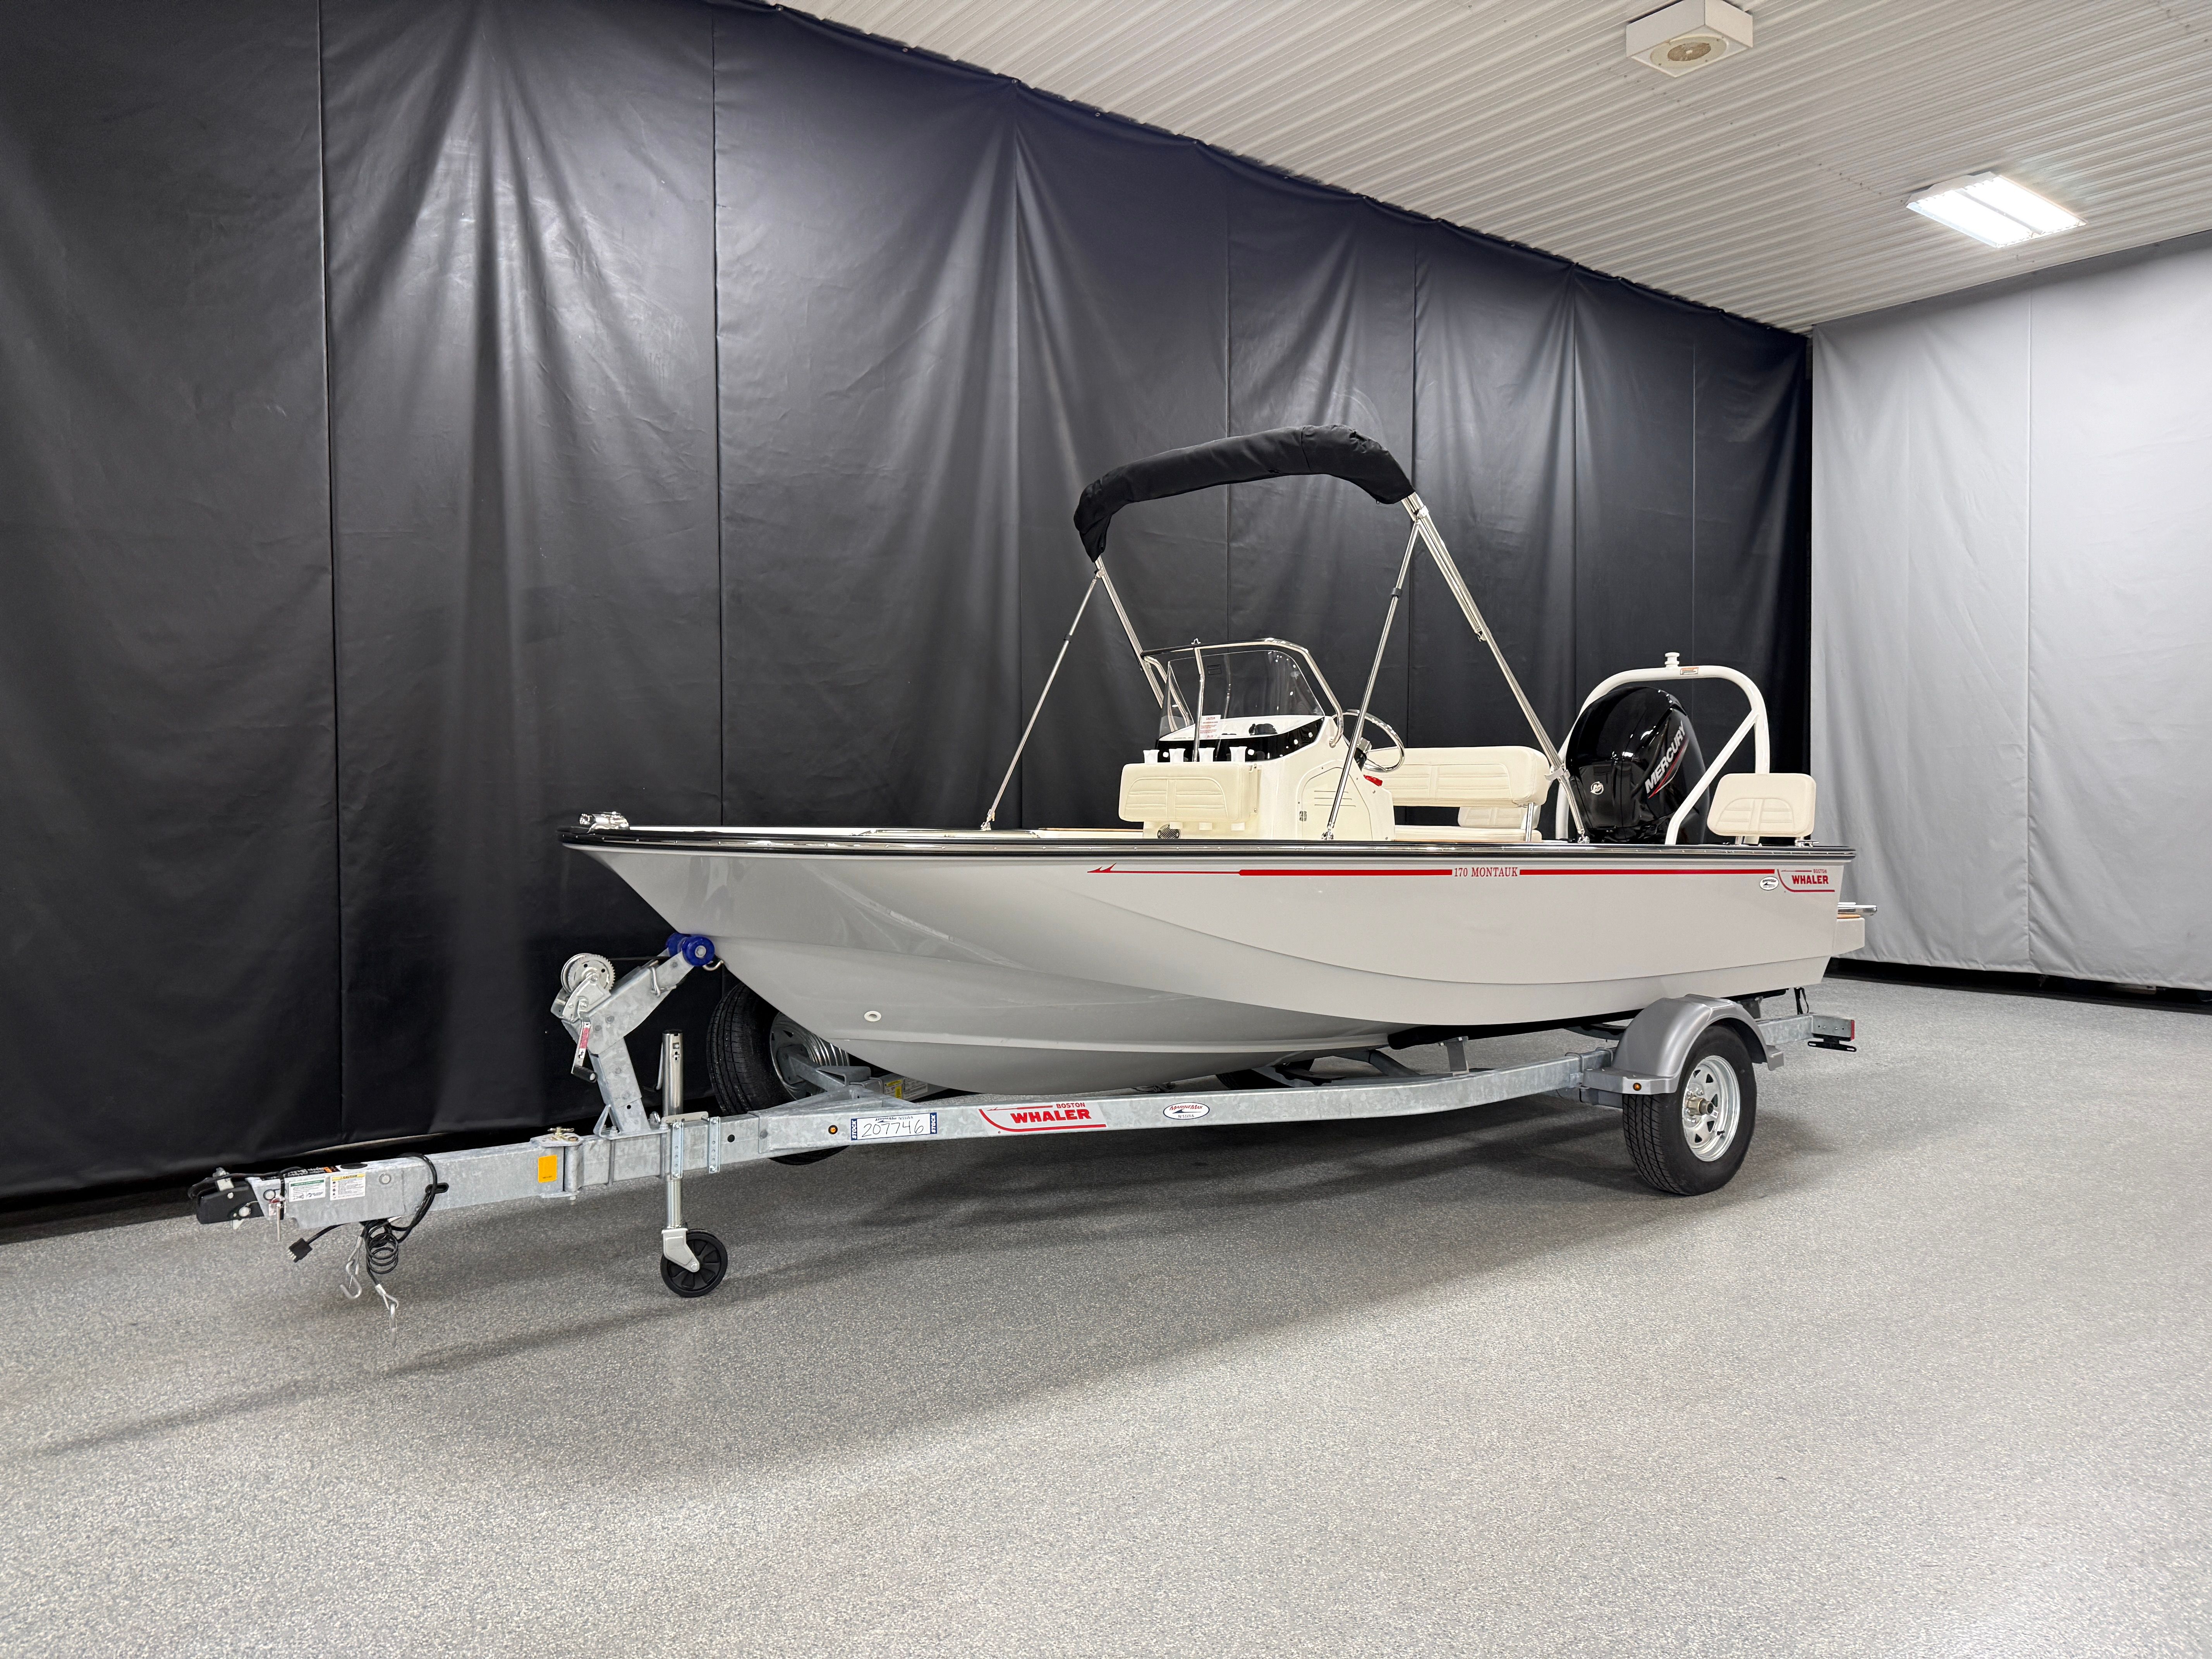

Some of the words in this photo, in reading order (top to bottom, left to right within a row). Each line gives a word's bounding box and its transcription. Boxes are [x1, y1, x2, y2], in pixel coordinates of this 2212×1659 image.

[1645, 720, 1685, 794] MERCURY
[1454, 868, 1468, 877] 170
[1471, 867, 1518, 877] MONTAUK
[1791, 875, 1829, 884] WHALER
[1010, 1109, 1092, 1123] WHALER
[861, 1120, 924, 1137] 207746
